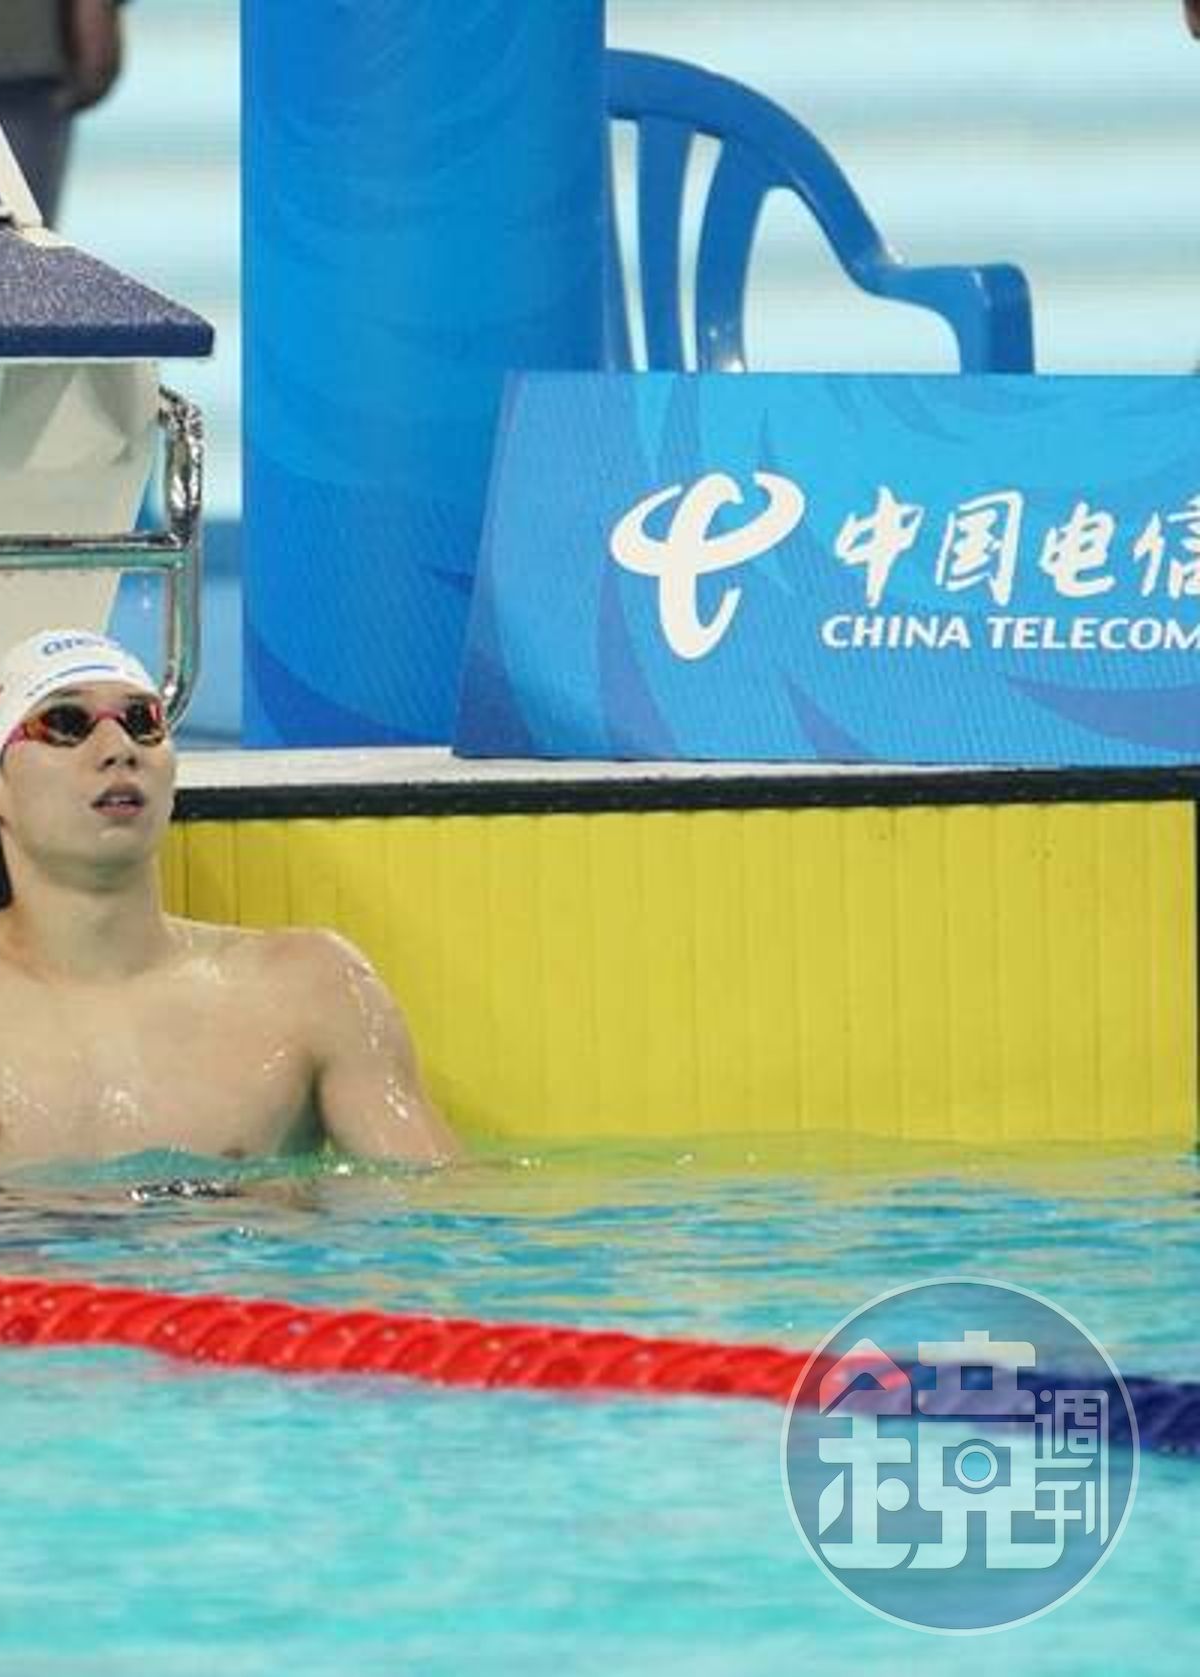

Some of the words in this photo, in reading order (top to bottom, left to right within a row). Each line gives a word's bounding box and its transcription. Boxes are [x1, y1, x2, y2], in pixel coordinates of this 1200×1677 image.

[834, 485, 1200, 607] 中国电信
[821, 613, 971, 650] CHINA
[987, 615, 1200, 650] TELECOM
